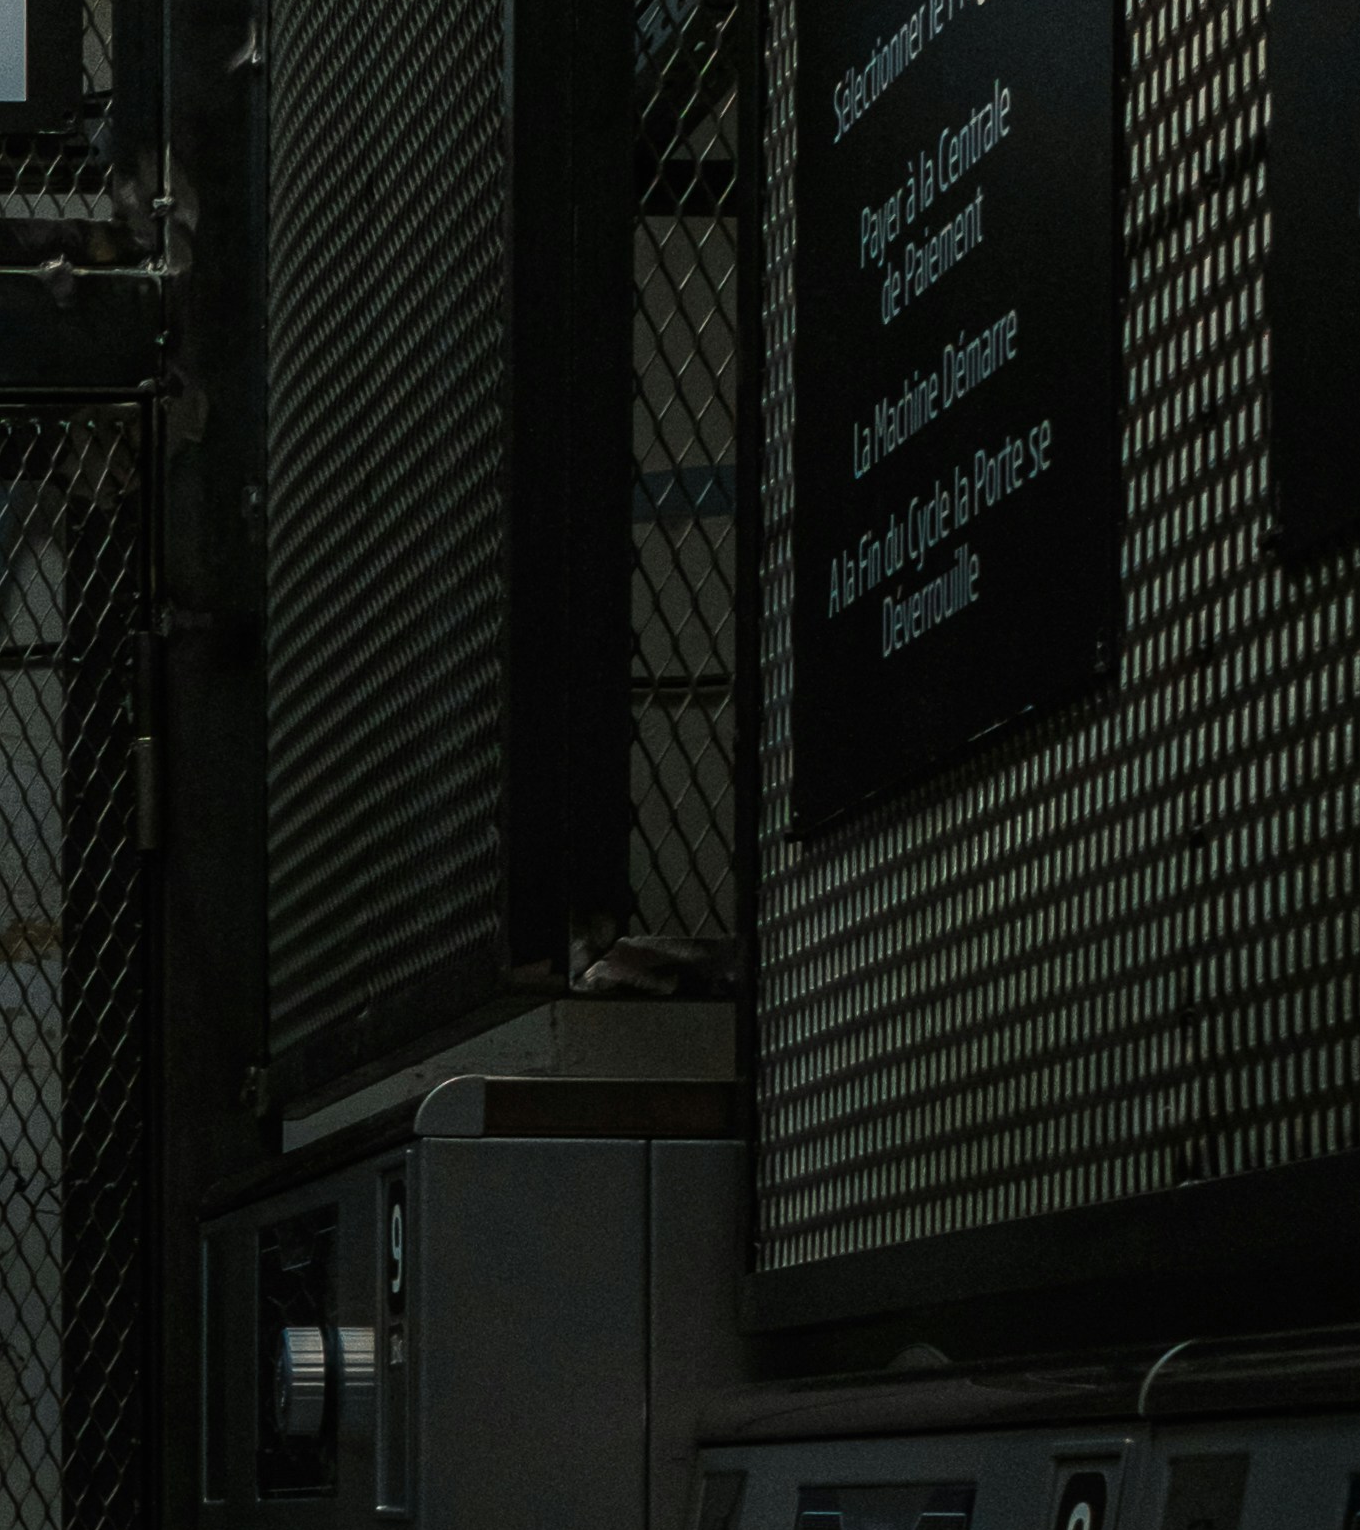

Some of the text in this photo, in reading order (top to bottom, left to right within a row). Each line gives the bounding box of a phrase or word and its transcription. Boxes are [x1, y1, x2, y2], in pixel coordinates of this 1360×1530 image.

[833, 4, 926, 145] Sélectionner
[861, 78, 1011, 270] Payer à la Centrale
[881, 186, 984, 325] de Paiement
[853, 309, 1019, 480] La Machine Démarre
[828, 418, 1053, 619] A la Fin du Cycle la Porte se
[882, 542, 981, 658] Déverrouille
[391, 1202, 403, 1294] 9
